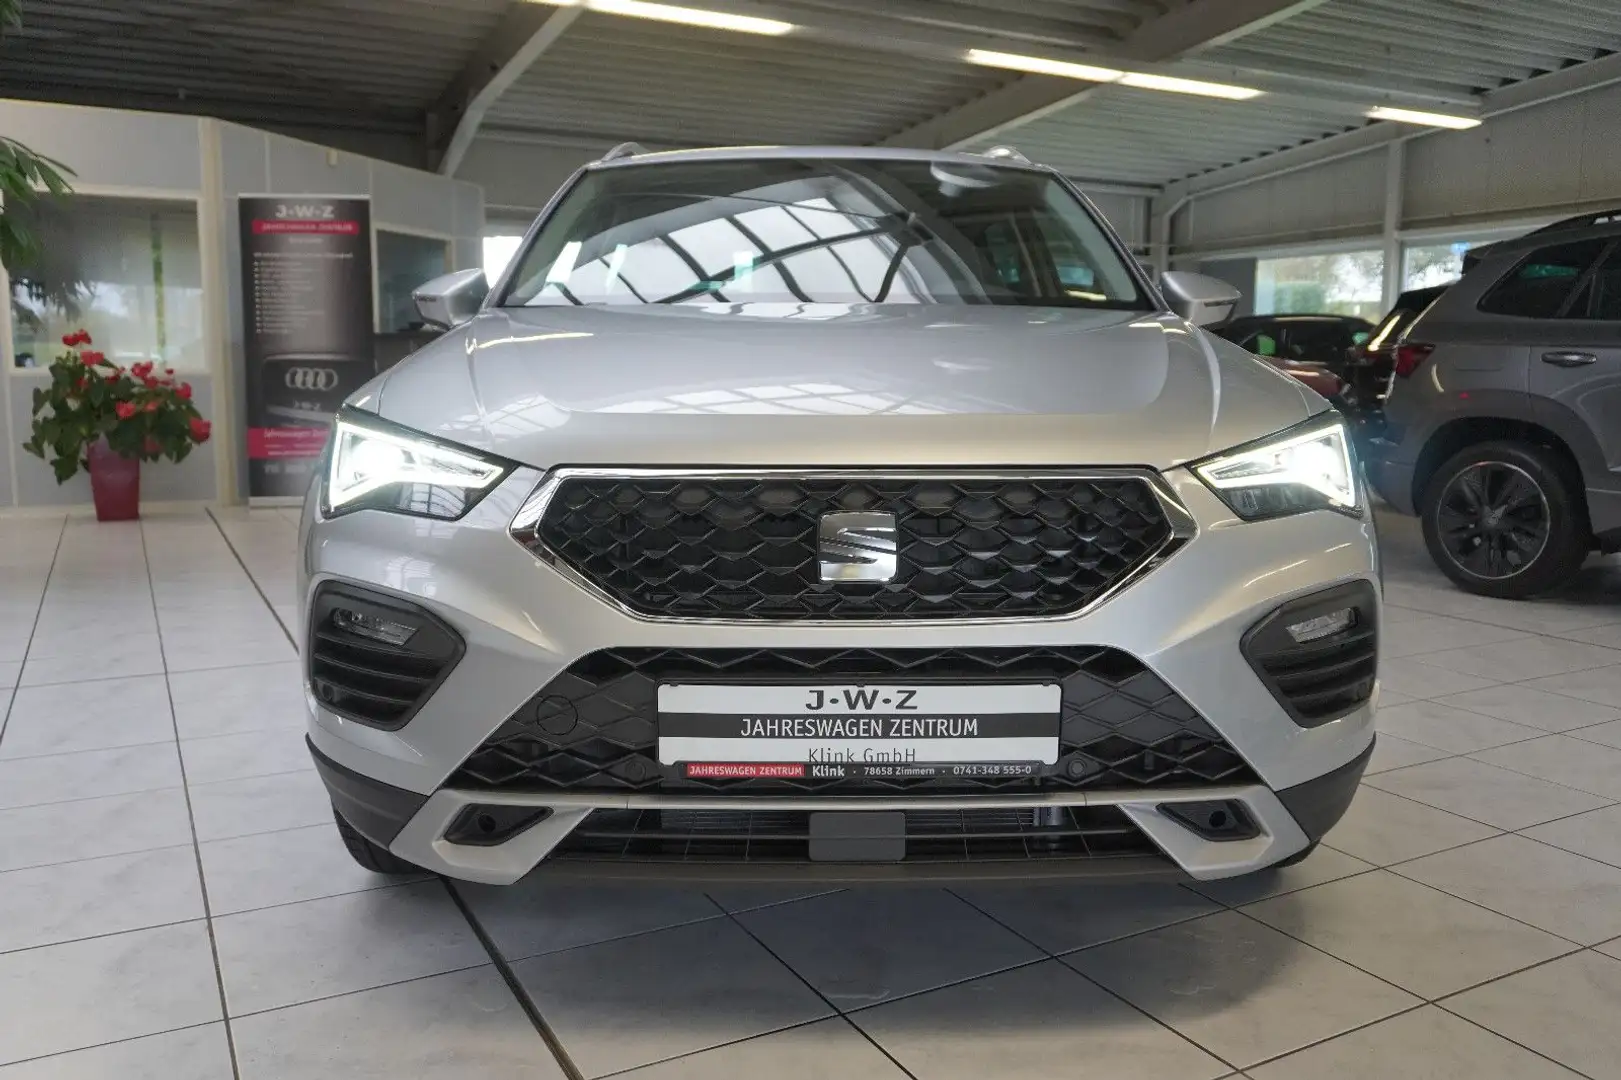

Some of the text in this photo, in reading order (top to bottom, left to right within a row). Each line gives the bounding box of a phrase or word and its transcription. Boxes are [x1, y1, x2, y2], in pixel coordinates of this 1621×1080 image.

[740, 718, 978, 737] JAHRESWAGEN ZENTRUM
[808, 747, 916, 763] Klink GmbH
[689, 765, 1032, 777] JAHRESWAGEN ZENTRUM Klink 78658 Zimmern 0741-348 555-0
